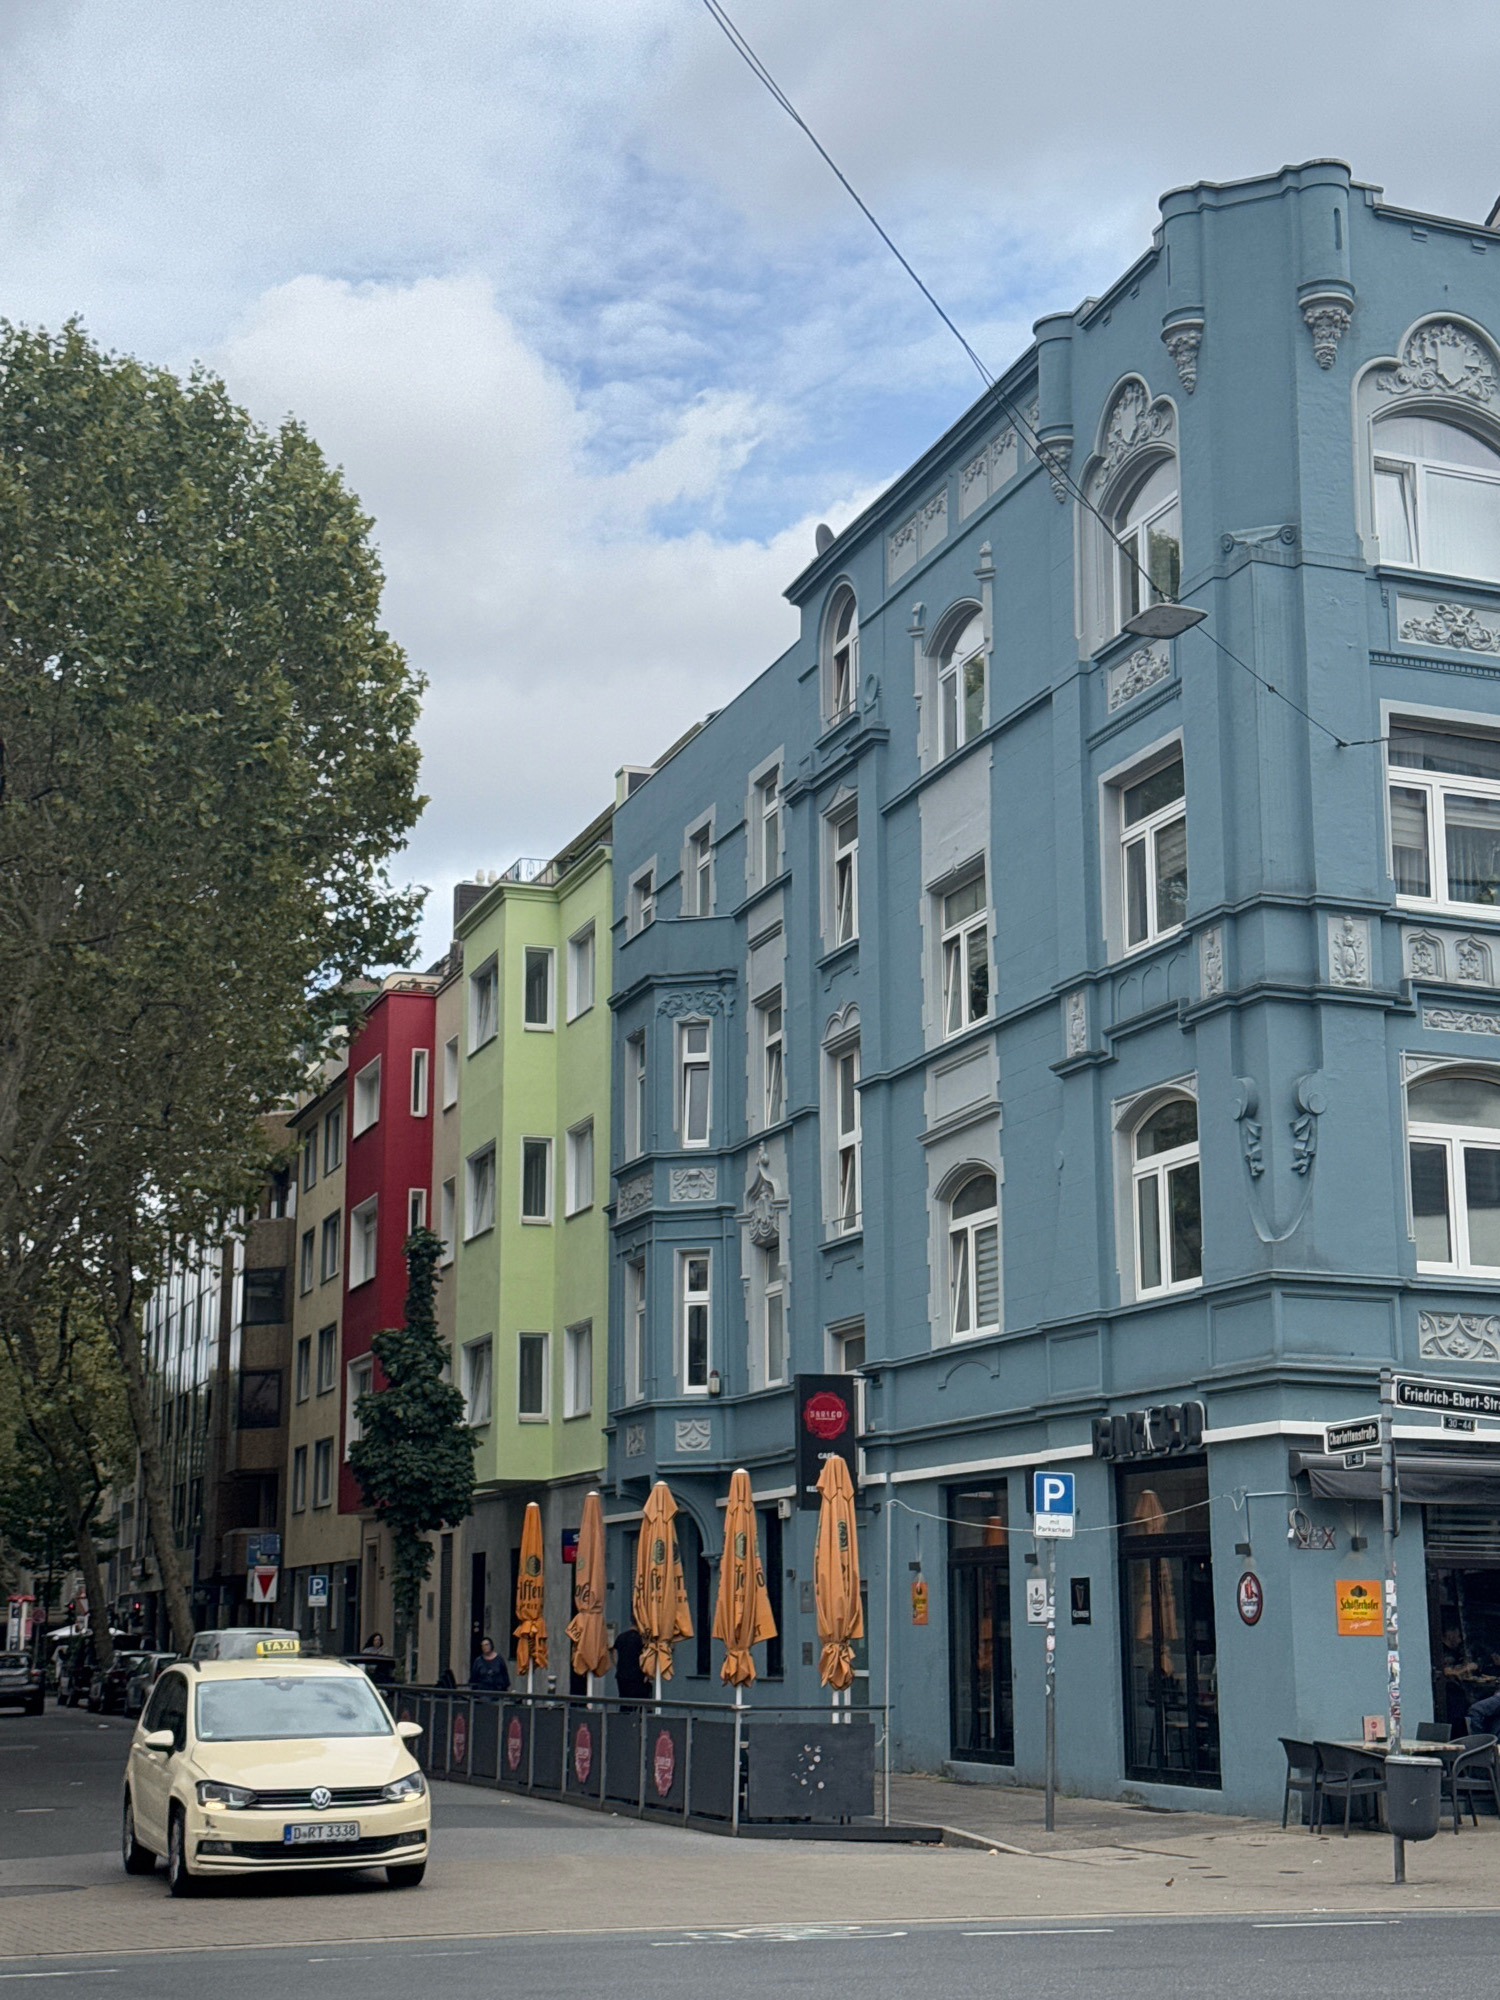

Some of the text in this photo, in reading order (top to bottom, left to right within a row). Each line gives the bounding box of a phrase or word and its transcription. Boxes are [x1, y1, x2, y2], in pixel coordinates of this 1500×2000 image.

[1404, 1386, 1500, 1411] Friedrich-Ebert-Str
[1329, 1425, 1376, 1446] Charlottenstraße
[1043, 1478, 1066, 1512] P
[1038, 1525, 1071, 1534] Parkschein
[312, 1578, 324, 1595] P
[264, 1641, 293, 1651] TAXI
[326, 1824, 356, 1838] 3338
